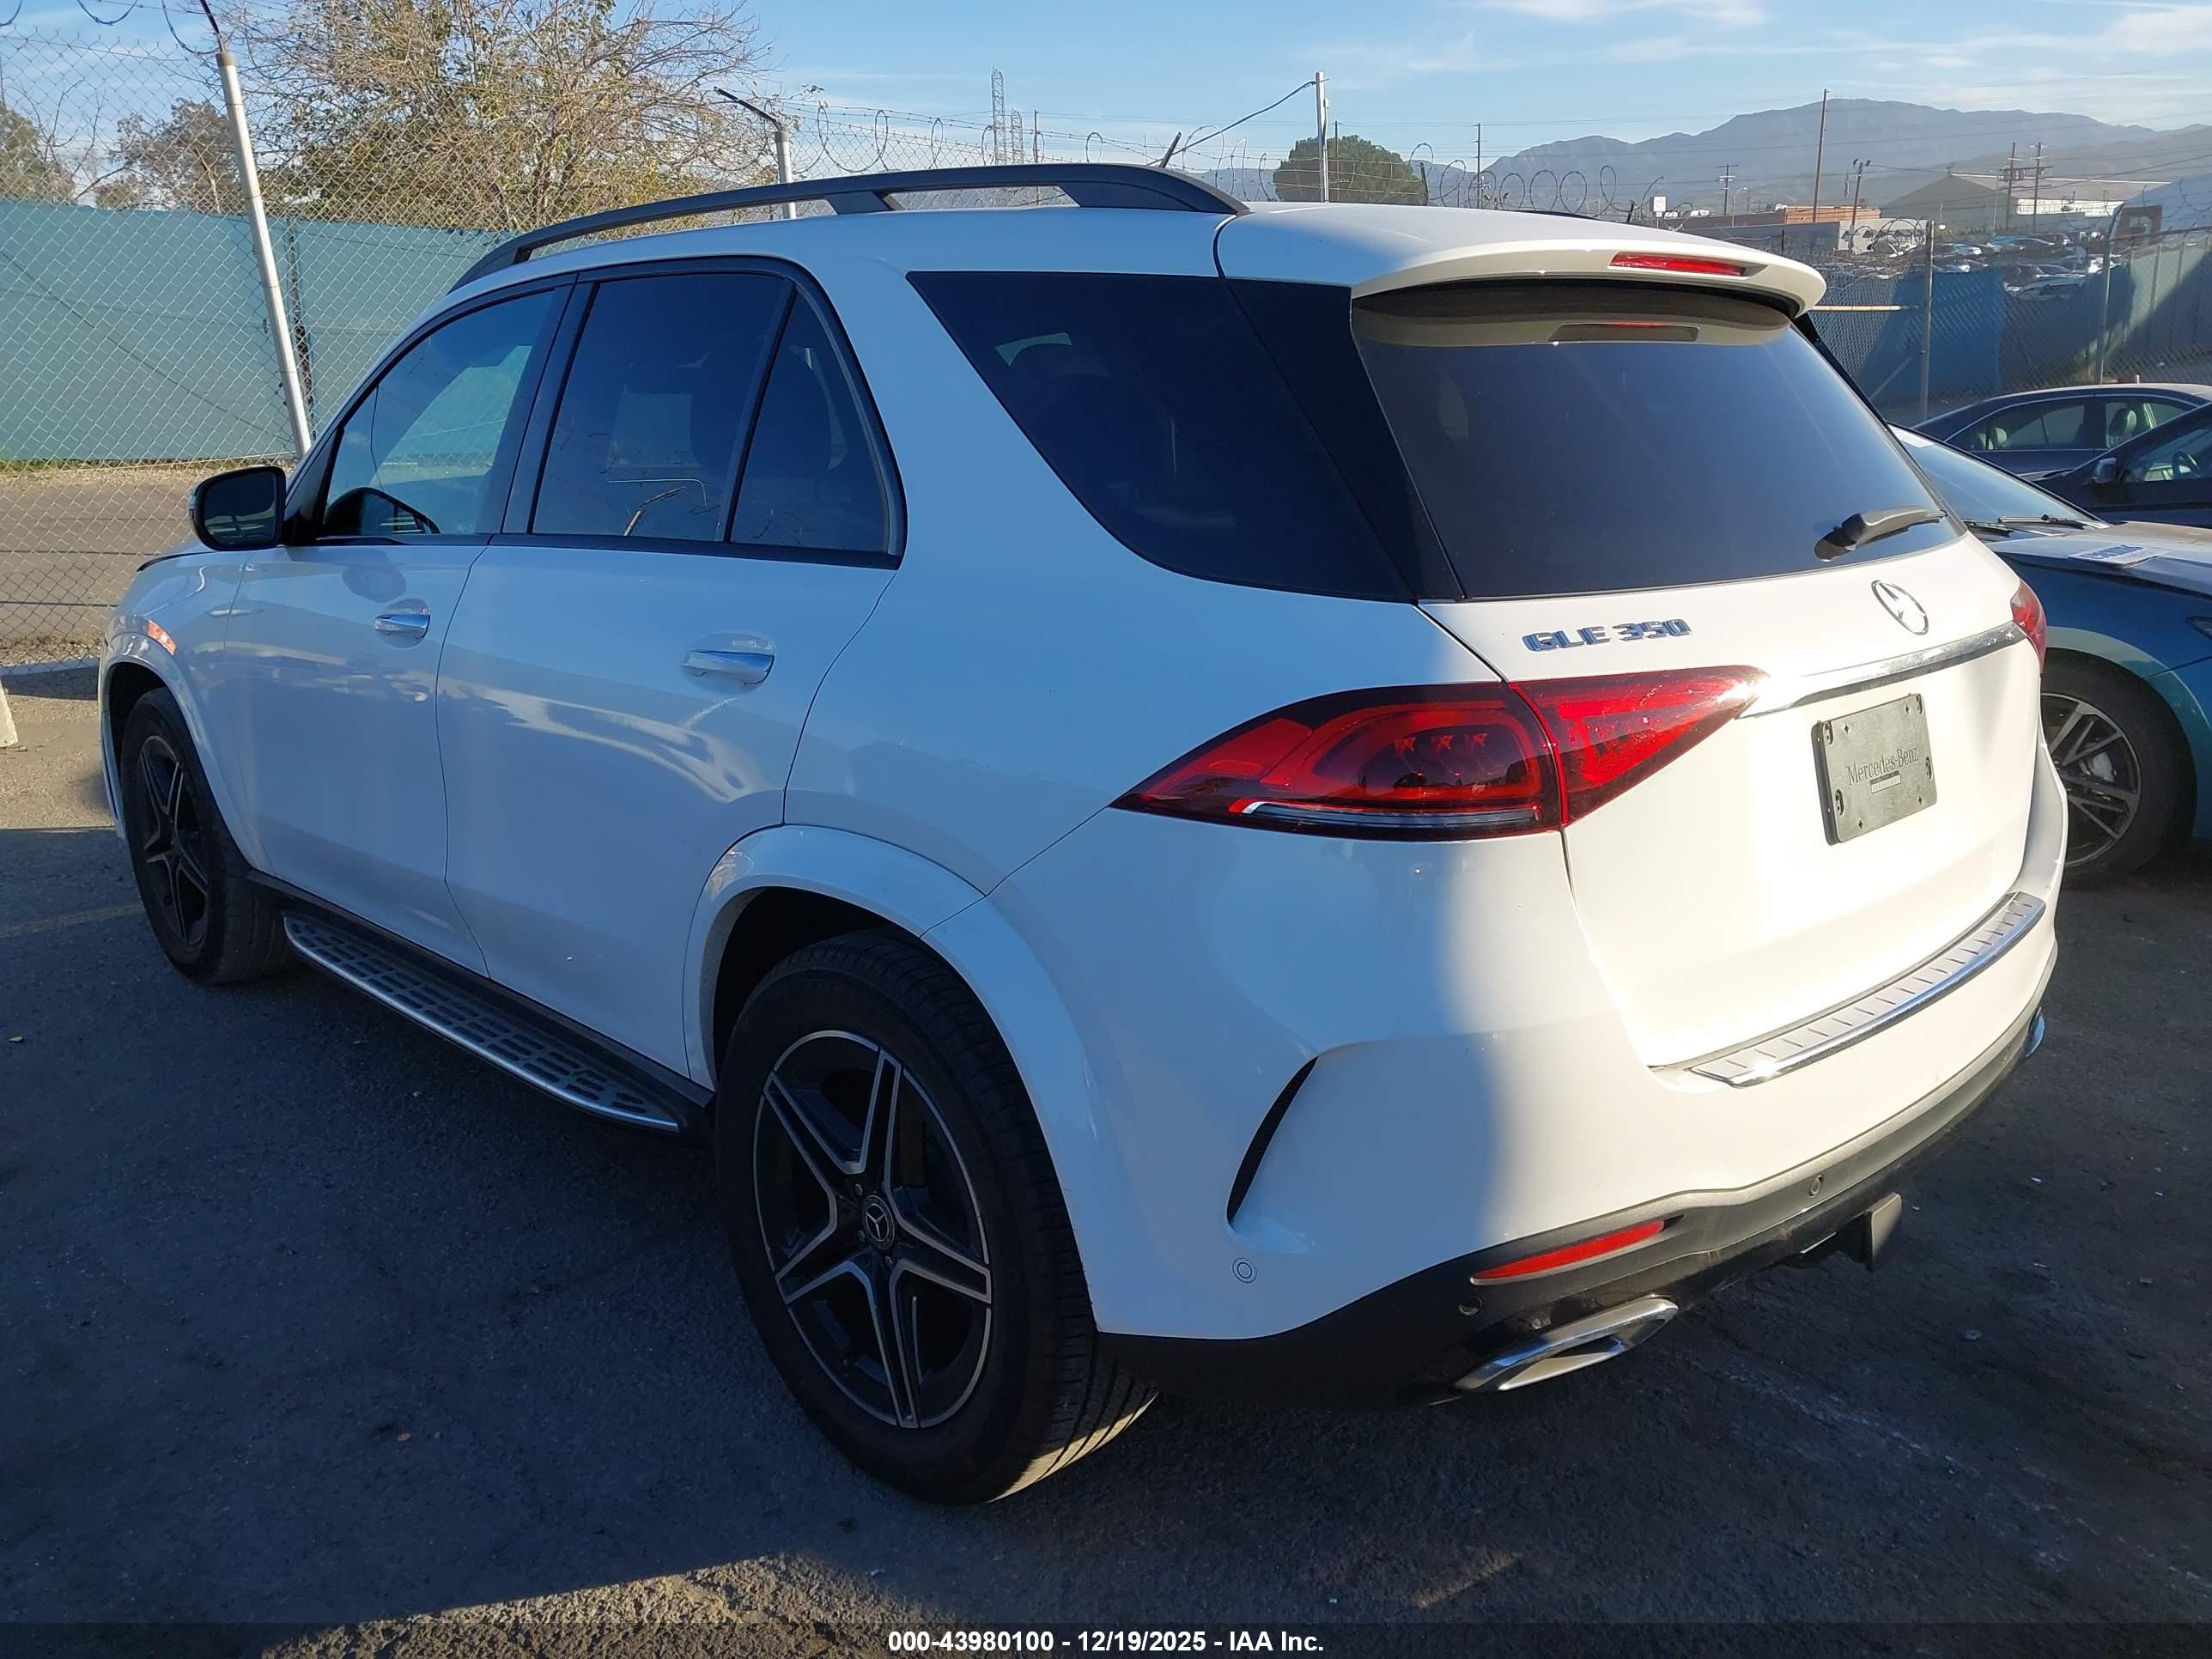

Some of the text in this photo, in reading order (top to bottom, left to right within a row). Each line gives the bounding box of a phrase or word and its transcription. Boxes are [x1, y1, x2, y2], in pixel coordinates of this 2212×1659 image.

[1522, 618, 1692, 652] GLE 350
[1846, 748, 1919, 786] Mercedes-Benz
